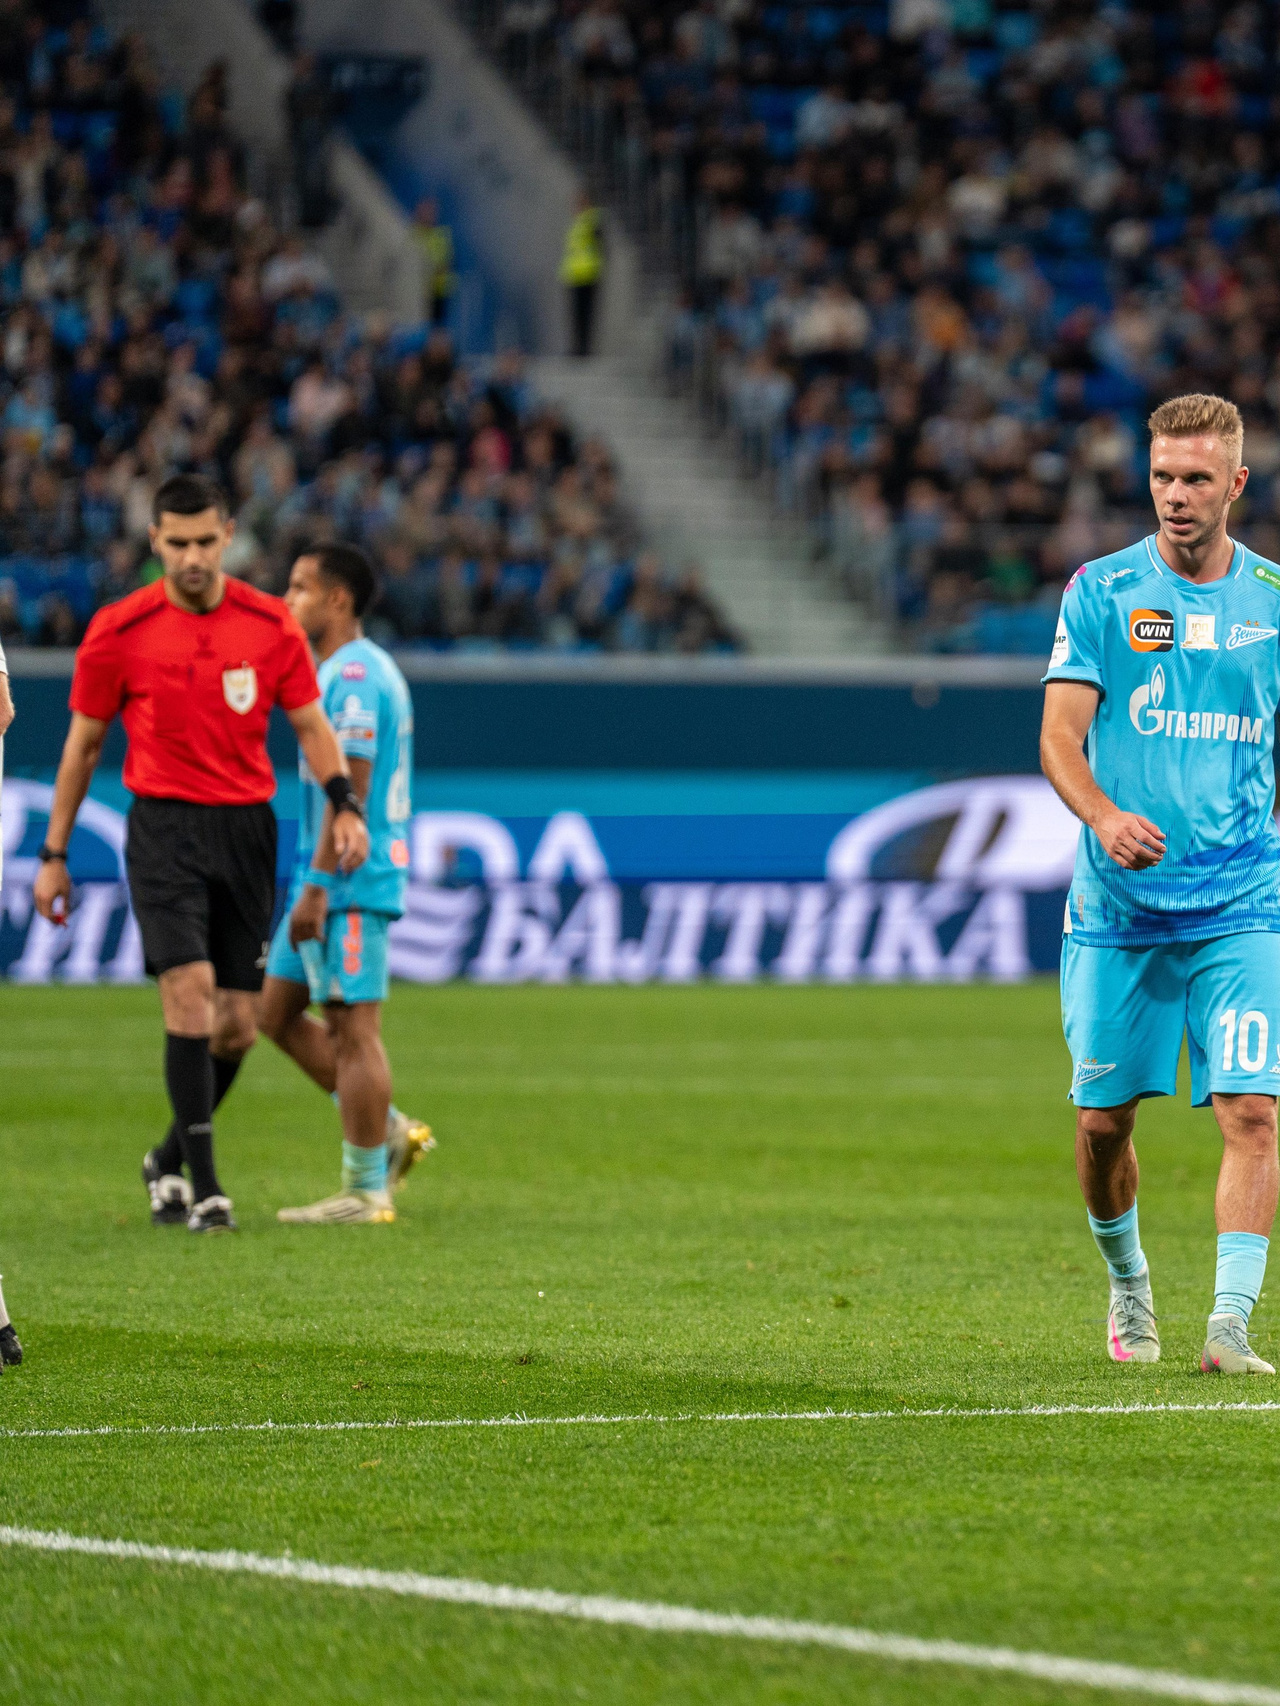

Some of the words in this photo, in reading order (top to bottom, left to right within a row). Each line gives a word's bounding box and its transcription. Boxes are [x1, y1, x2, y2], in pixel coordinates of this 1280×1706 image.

[1139, 624, 1171, 638] WIN
[1165, 709, 1263, 744] ГАЗПРОМ
[469, 879, 1031, 984] БАЛТИКА
[1219, 1009, 1269, 1073] 10
